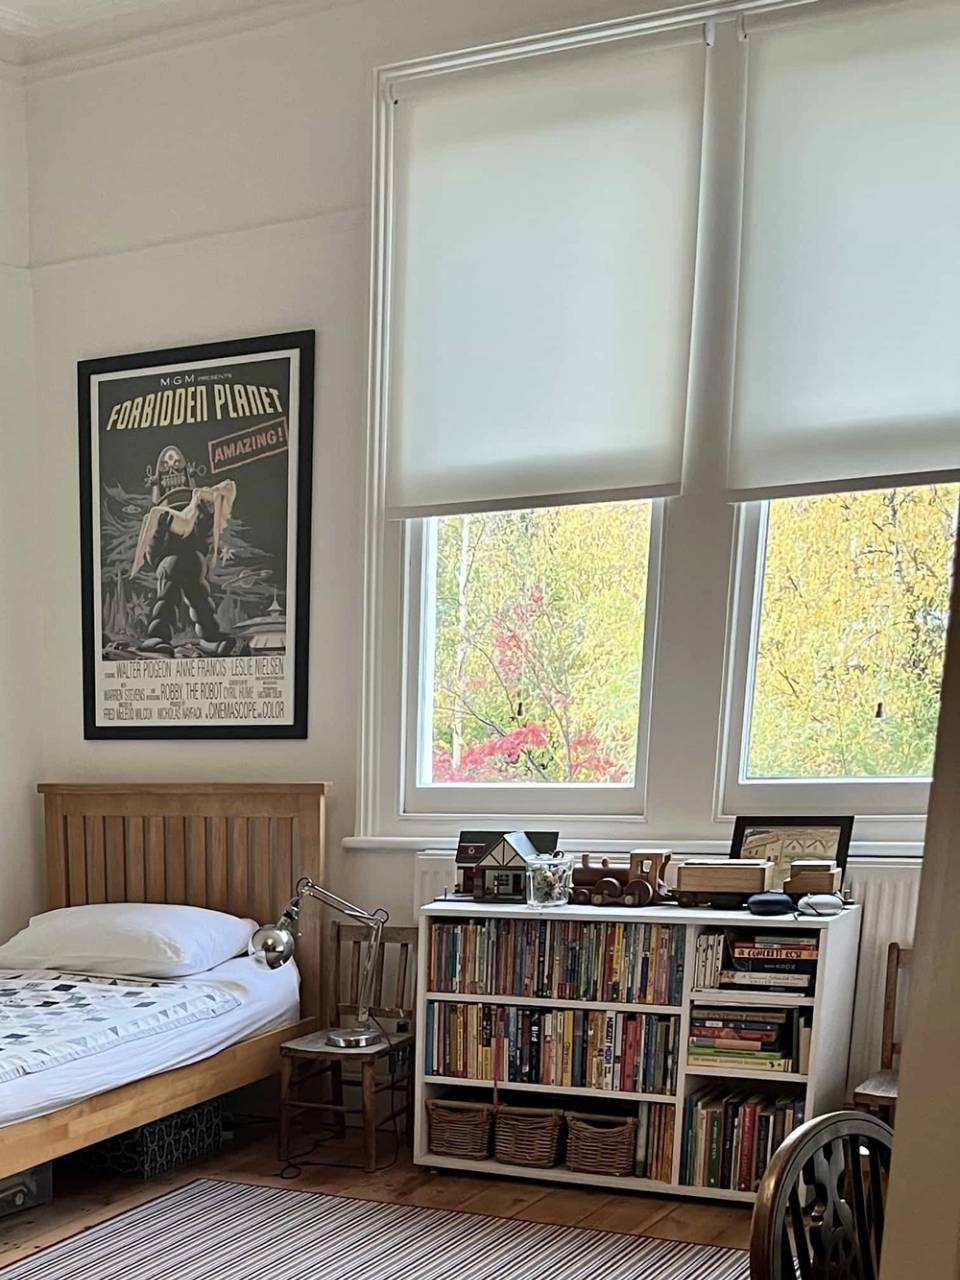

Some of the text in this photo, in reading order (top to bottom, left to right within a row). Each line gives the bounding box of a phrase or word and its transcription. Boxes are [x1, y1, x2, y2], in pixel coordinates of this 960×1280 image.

[106, 383, 283, 431] FORBIDDEN PLANET
[214, 429, 283, 463] AMAZING!
[116, 660, 172, 679] WALTER PIDGEON
[176, 658, 226, 677] ANNE FRANCIS
[232, 657, 284, 676] LESLIE NIELSEN
[186, 682, 198, 700] THE
[201, 681, 223, 700] ROBOT
[208, 701, 284, 719] CINEMASCOPE COLOR
[531, 1026, 539, 1042] Bird
